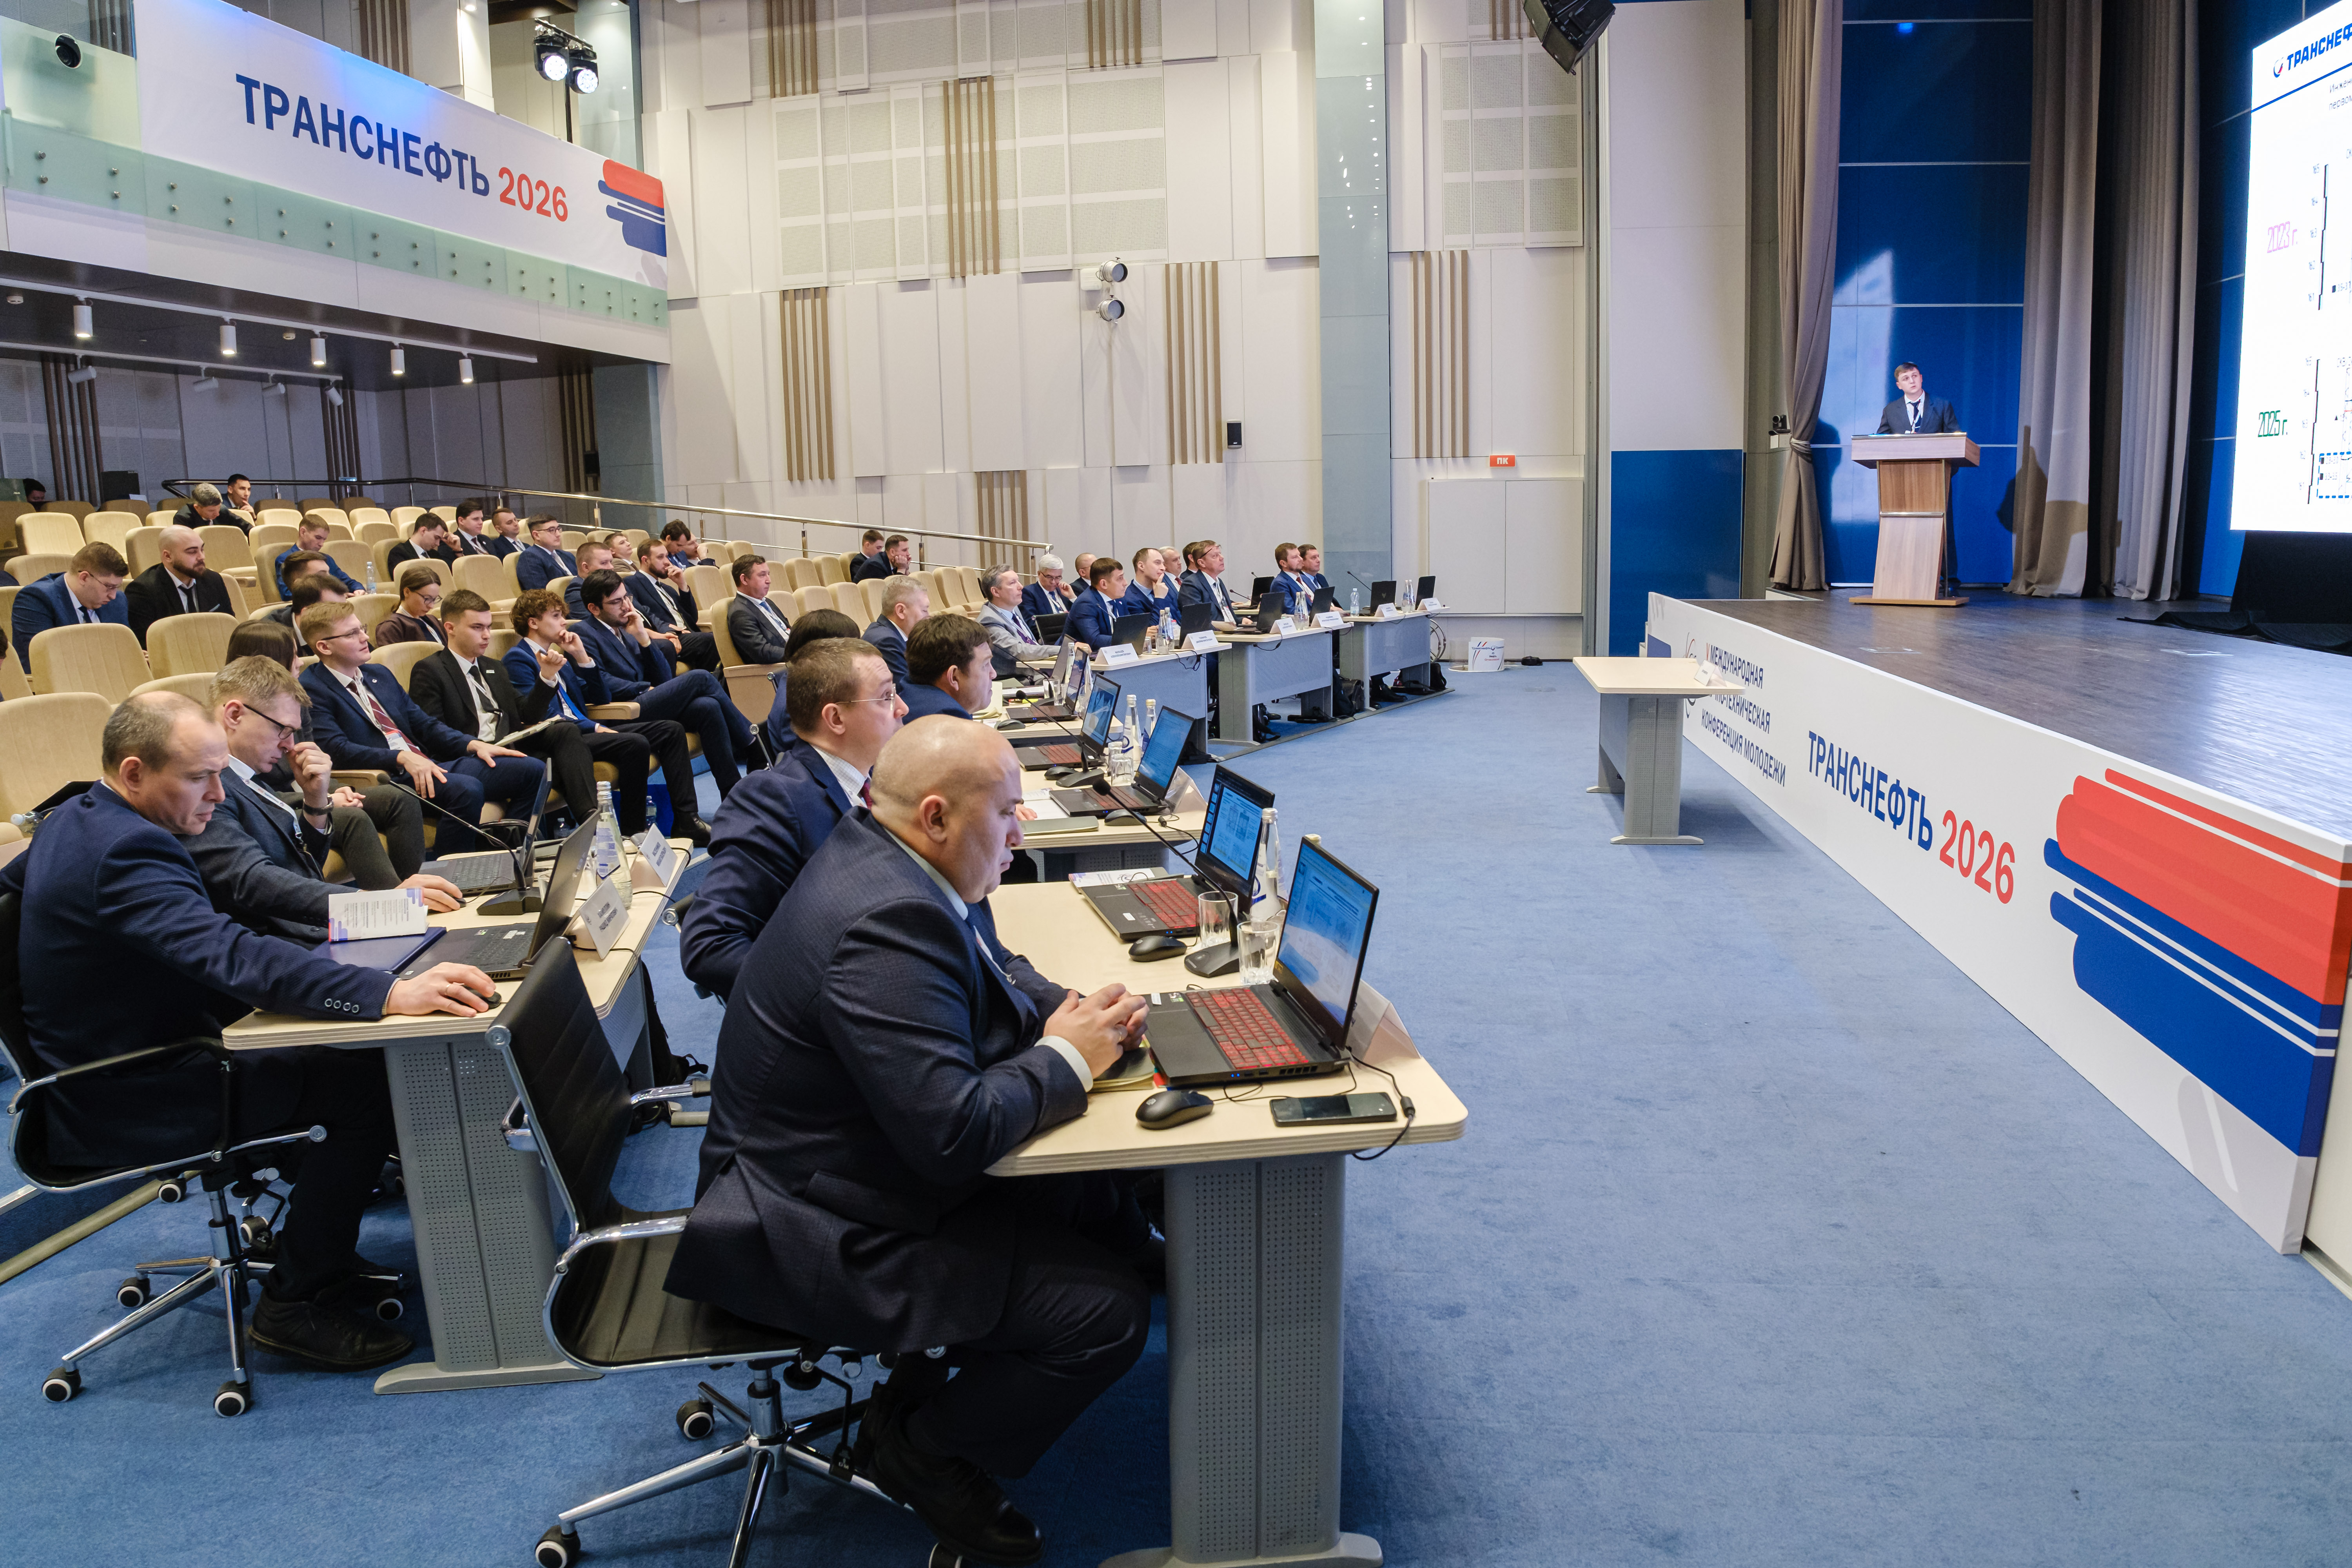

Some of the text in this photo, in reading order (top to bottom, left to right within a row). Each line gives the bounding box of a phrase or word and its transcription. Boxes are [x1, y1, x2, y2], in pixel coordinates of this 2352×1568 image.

[2330, 78, 2352, 94] Инжен
[236, 73, 568, 222] ТРАНСНЕФТЬ 2026
[2267, 221, 2298, 253] 2023 г.
[2258, 410, 2288, 437] 2025 г.
[1710, 644, 1764, 689] МЕЖДУНАРОДНАЯ
[1709, 695, 1770, 734] О-ТЕХНИЧЕСКАЯ
[1701, 708, 1786, 787] КОНФЕРЕНЦИЯ МОЛОДЕЖИ
[1809, 731, 2015, 904] ТРАНСНЕФТЬ 2026
